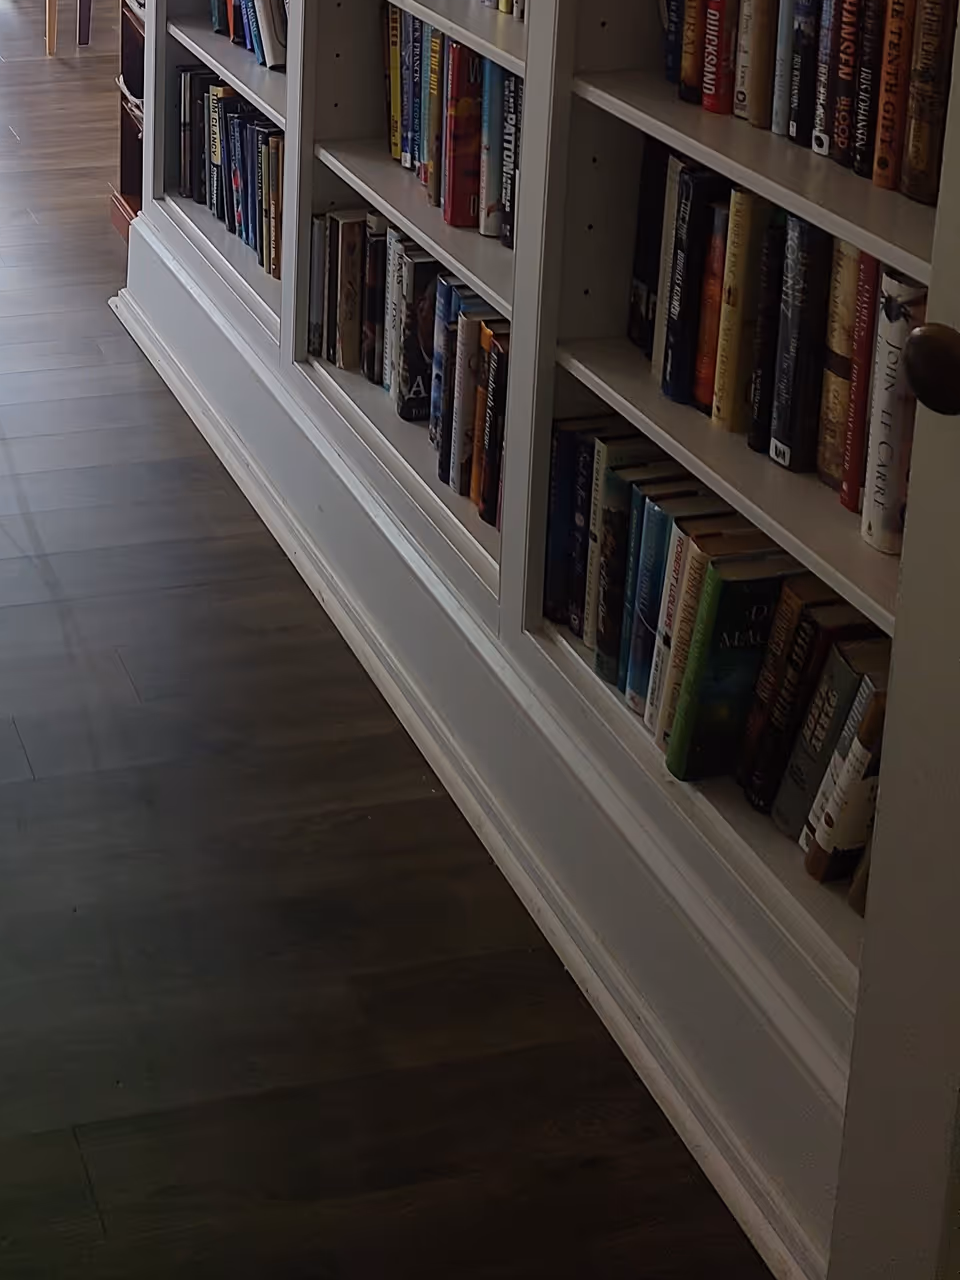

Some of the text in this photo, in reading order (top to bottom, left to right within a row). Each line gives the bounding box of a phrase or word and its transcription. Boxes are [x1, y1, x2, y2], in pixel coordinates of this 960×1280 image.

[412, 42, 421, 82] FRANCIS
[701, 8, 720, 96] QUICKSAND
[883, 25, 904, 96] TENTH
[211, 91, 219, 115] TOM
[859, 67, 873, 91] IRIS
[211, 116, 219, 157] CLANCY
[412, 96, 420, 131] SECOND
[836, 96, 851, 149] BLOOD
[854, 89, 871, 150] JOHANSEN
[502, 113, 516, 174] PATTON
[780, 227, 800, 319] KOONTZ
[486, 350, 499, 408] Elizabeth
[883, 339, 903, 392] JOHN
[670, 535, 685, 584] ROBERT
